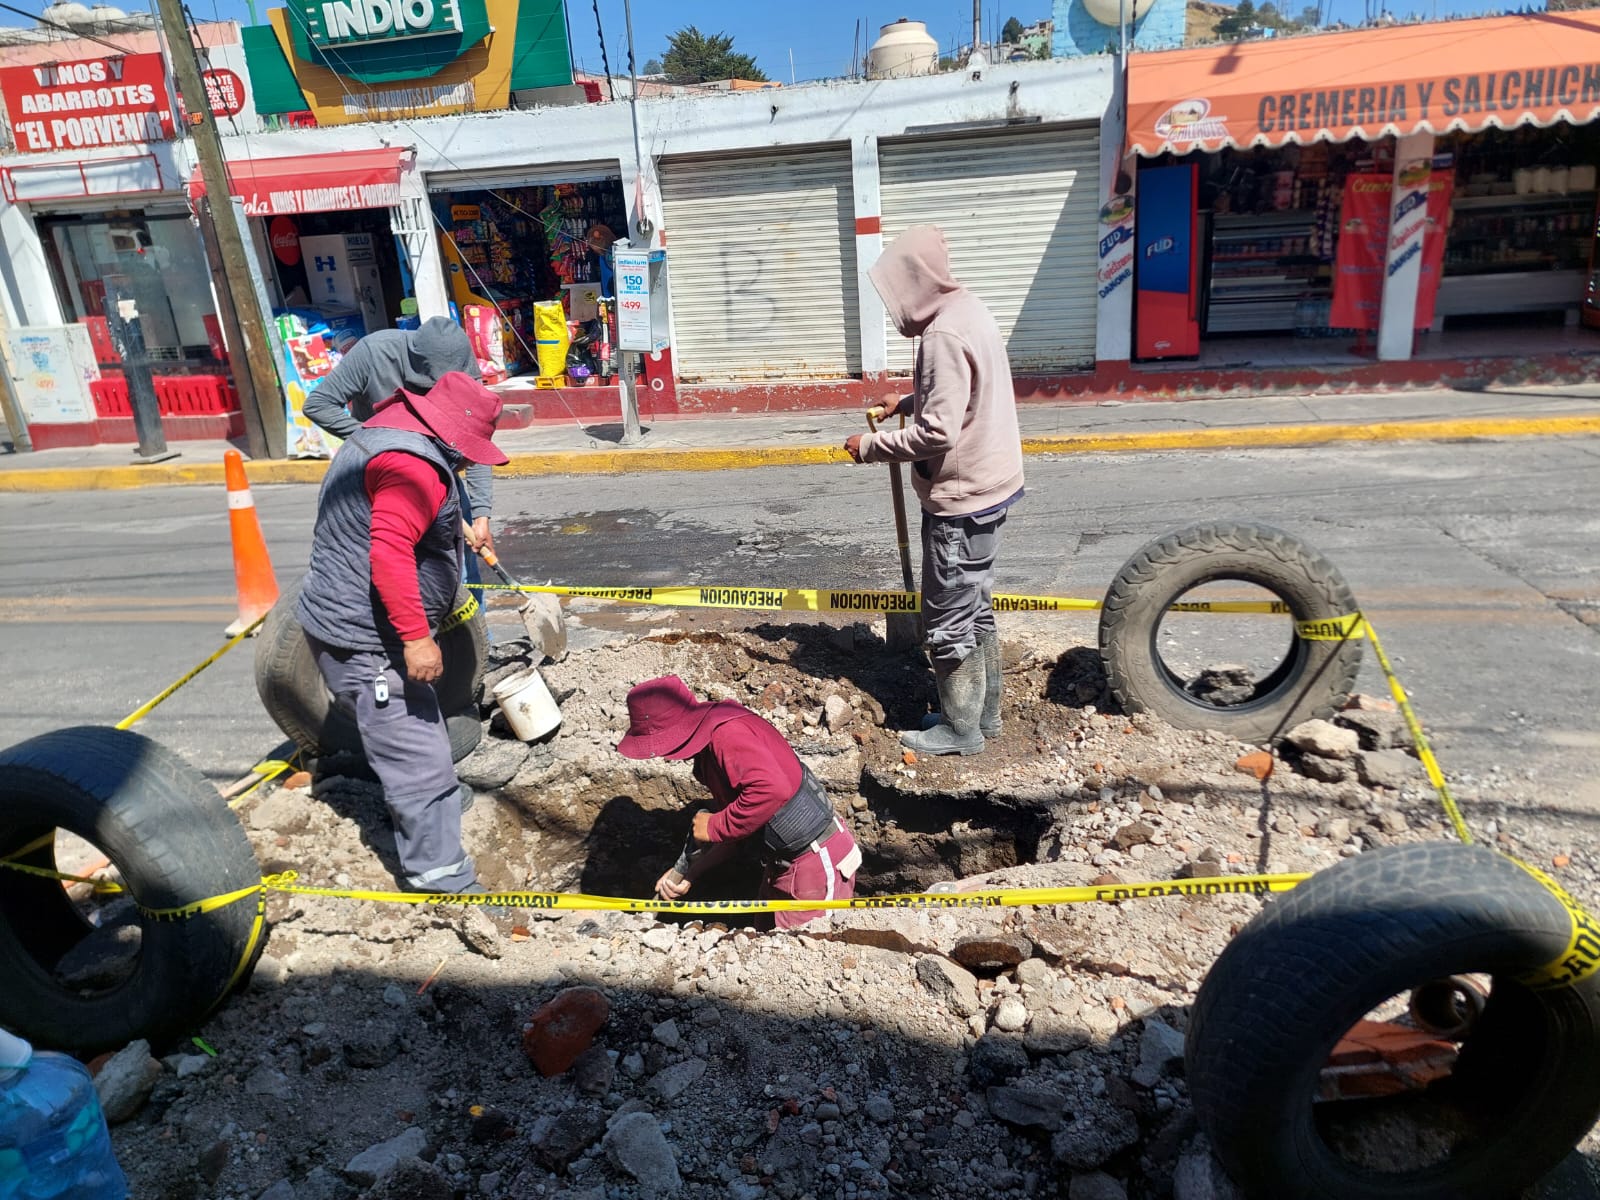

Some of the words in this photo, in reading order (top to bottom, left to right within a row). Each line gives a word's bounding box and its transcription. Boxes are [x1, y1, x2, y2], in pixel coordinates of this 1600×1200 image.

[321, 0, 435, 38] INDIO
[33, 62, 107, 87] VINOS
[107, 61, 124, 80] Y
[220, 74, 233, 85] TE
[22, 84, 155, 114] ABARROTES
[1258, 84, 1407, 133] CREMERIA
[1416, 82, 1436, 120] Y
[1101, 231, 1121, 254] FUD
[1147, 239, 1173, 257] FUD
[623, 275, 643, 285] 150
[1099, 268, 1132, 299] DANONE
[700, 588, 783, 606] PRECAUCION
[830, 593, 916, 610] PRECAUCION
